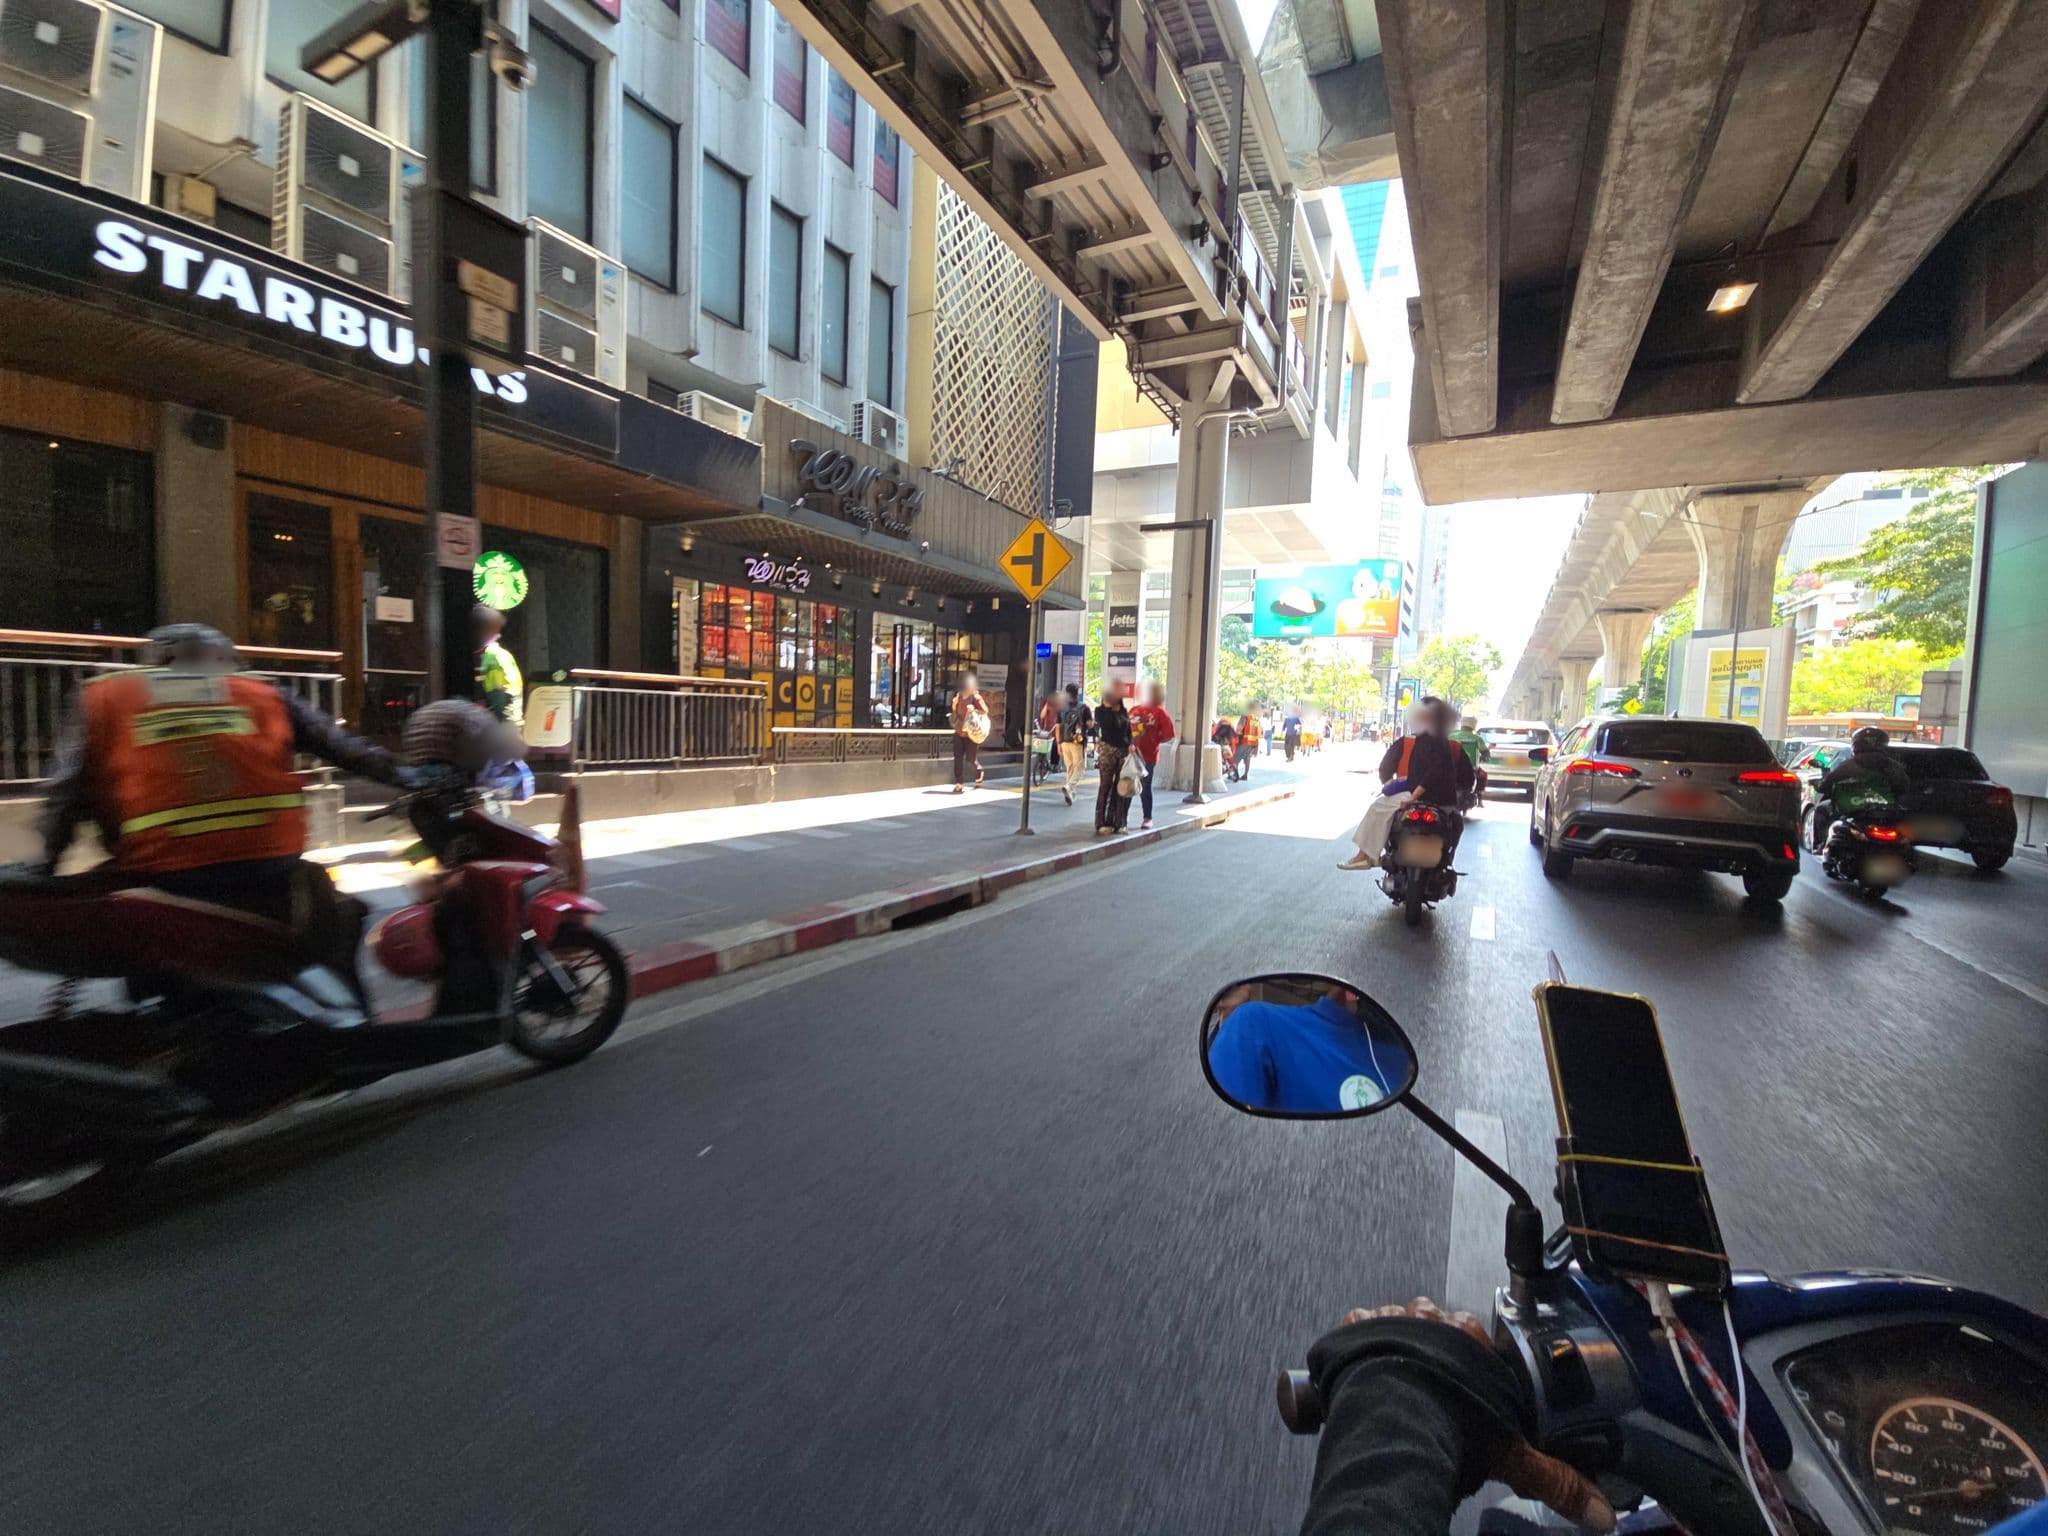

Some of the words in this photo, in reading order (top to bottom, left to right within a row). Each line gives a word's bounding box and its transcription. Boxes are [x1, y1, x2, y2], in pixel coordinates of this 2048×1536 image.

[93, 220, 528, 404] STARBUS
[1888, 1442, 1913, 1455] 40
[1980, 1437, 2006, 1450] 100
[1892, 1471, 1917, 1485] 20
[2004, 1466, 2029, 1478] 120
[1908, 1505, 1922, 1516] 0
[1954, 1514, 1987, 1528] km/h
